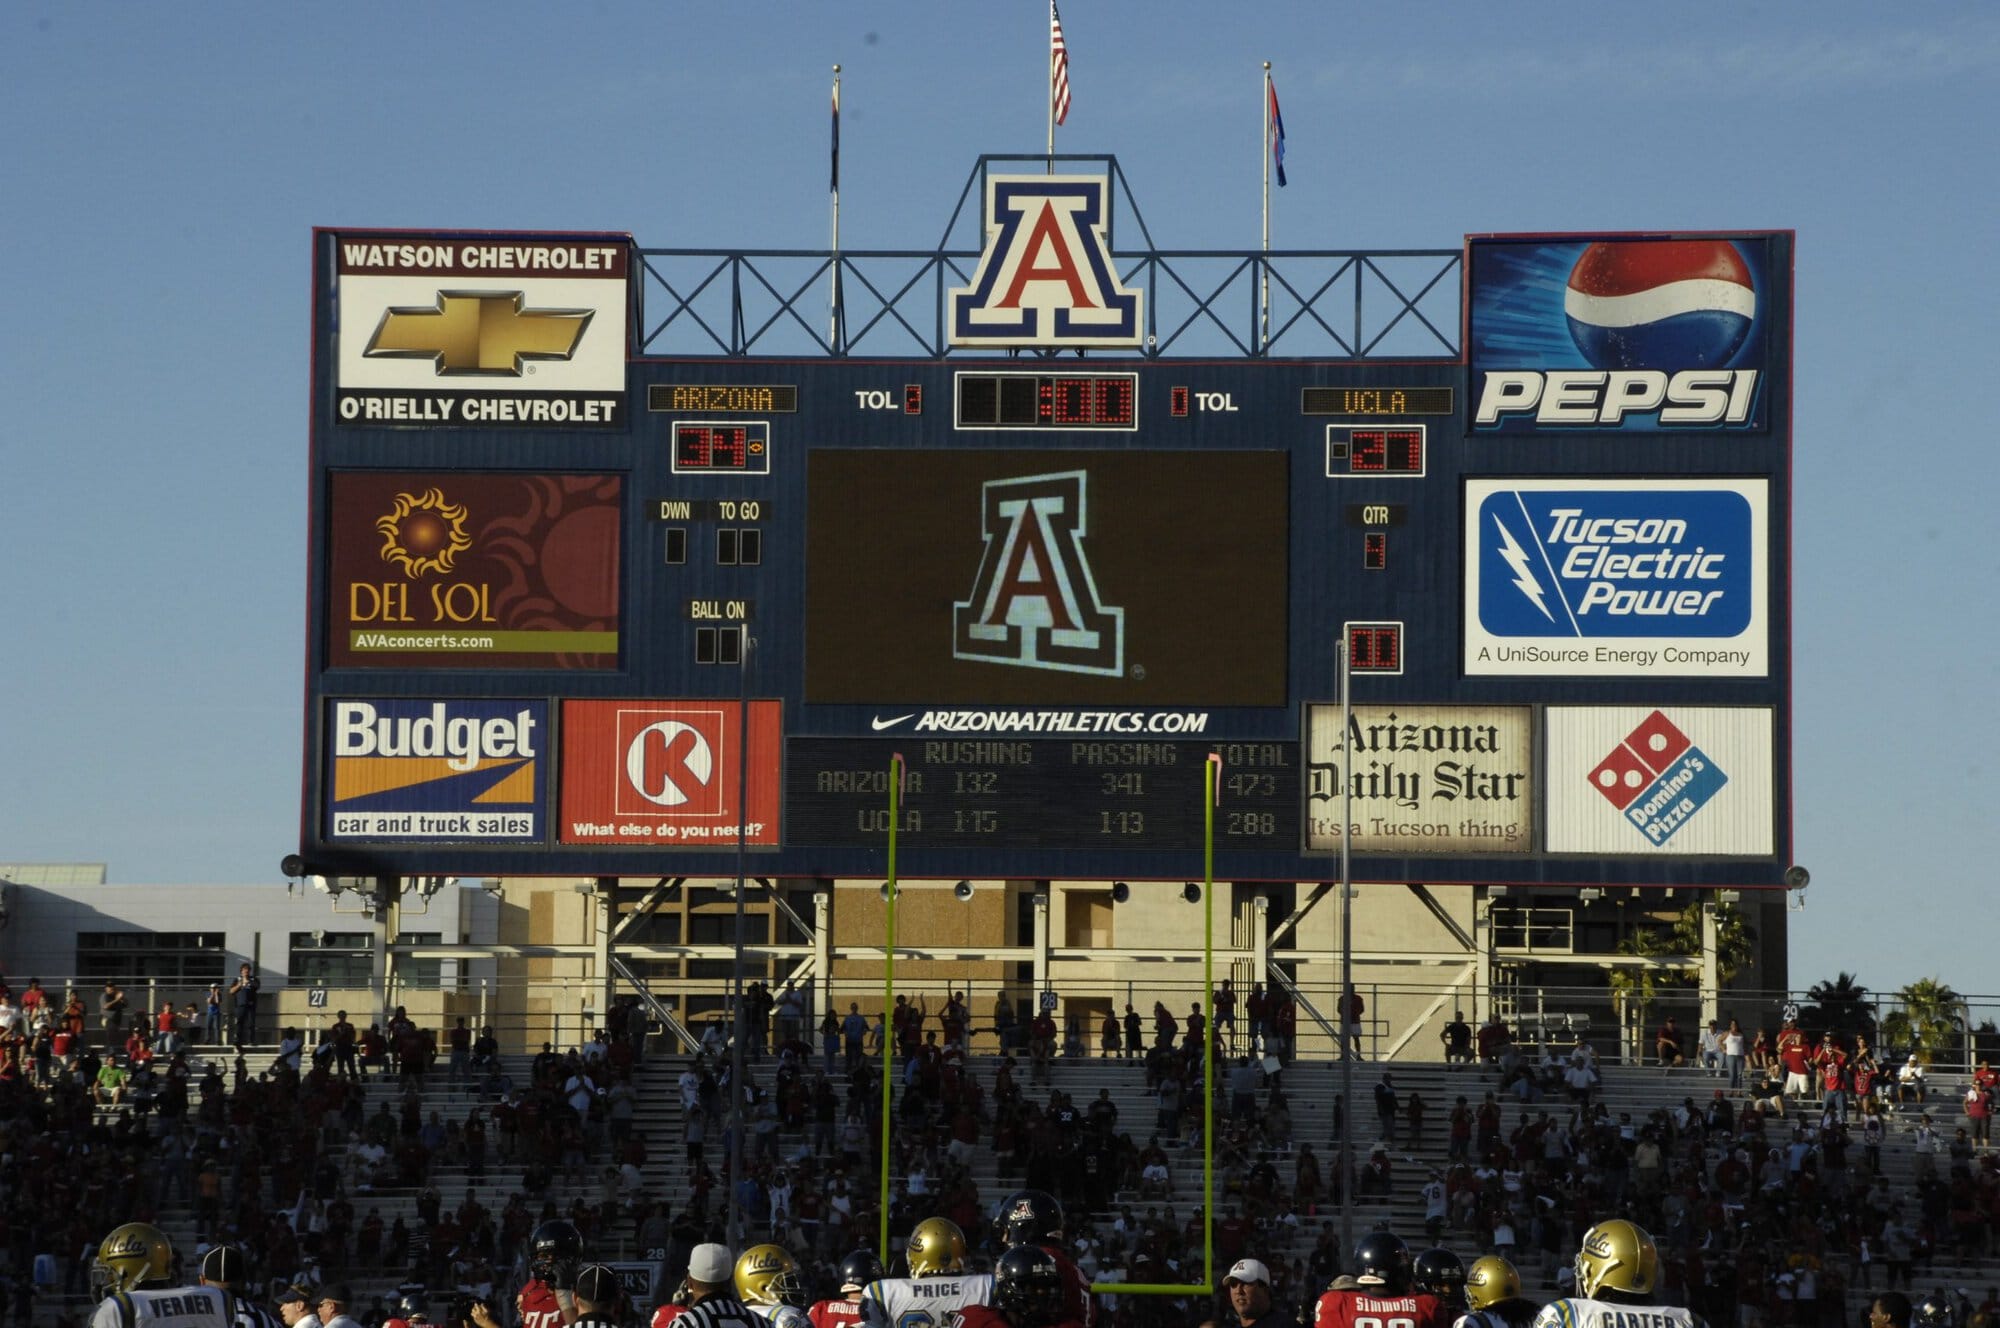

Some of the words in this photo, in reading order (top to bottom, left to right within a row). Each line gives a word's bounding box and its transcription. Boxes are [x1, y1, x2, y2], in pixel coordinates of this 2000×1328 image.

[344, 244, 453, 268] WATSON
[461, 246, 617, 270] CHEVROLET
[674, 387, 772, 411] ARIZONA
[855, 391, 898, 409] TOL
[1195, 392, 1239, 411] TOL
[1344, 391, 1405, 413] UCLA
[1475, 369, 1758, 424] PEPSI
[340, 397, 455, 420] O'RIELLY
[462, 399, 616, 422] CHEVROLET
[679, 428, 745, 466] 34
[1352, 432, 1420, 469] 27
[661, 502, 690, 520] DWN
[719, 502, 736, 520] TO
[740, 502, 760, 520] GO
[1363, 505, 1389, 525] QTR
[1547, 508, 1687, 544] Tucson
[1365, 534, 1385, 567] 4
[1561, 545, 1726, 580] Electric
[351, 583, 416, 622] DEL
[431, 583, 497, 622] SOL
[1577, 581, 1724, 615] Power
[691, 601, 722, 619] BALL
[726, 601, 745, 619] ON
[356, 634, 494, 649] AVAconcerts.com
[1478, 648, 1491, 662] A
[1497, 647, 1589, 662] UniSource
[1595, 648, 1657, 666] Energy
[1663, 648, 1750, 666] Company
[915, 711, 1208, 733] ARIZONAATHLETICS.COM
[1331, 712, 1501, 753] Arizona
[336, 702, 536, 771] Budget
[926, 741, 1032, 764] RUSHING
[1072, 743, 1176, 765] PASSING
[955, 771, 998, 793] 132
[1101, 772, 1144, 795] 341
[1228, 774, 1275, 796] 473
[1307, 759, 1420, 810] Daily
[1432, 760, 1526, 801] Star
[1628, 757, 1705, 826] Domino's
[337, 818, 369, 832] car
[377, 816, 412, 832] and
[419, 816, 470, 832] truck
[477, 816, 529, 833] sales
[573, 823, 615, 836] What
[619, 823, 652, 836] else
[656, 823, 676, 836] do
[681, 826, 709, 839] you
[1227, 812, 1275, 835] 288
[1309, 818, 1342, 836] It's
[1350, 825, 1362, 836] a
[1371, 817, 1450, 837] Tucson
[1459, 819, 1524, 842] thing.
[1645, 798, 1696, 842] Pizza
[311, 990, 325, 1006] 27
[1042, 993, 1057, 1009] 28
[1783, 1005, 1798, 1020] 29
[647, 1248, 665, 1260] 28
[913, 1282, 960, 1298] PRICE
[148, 1295, 215, 1318] VERNER
[1602, 1311, 1676, 1328] CARTER
